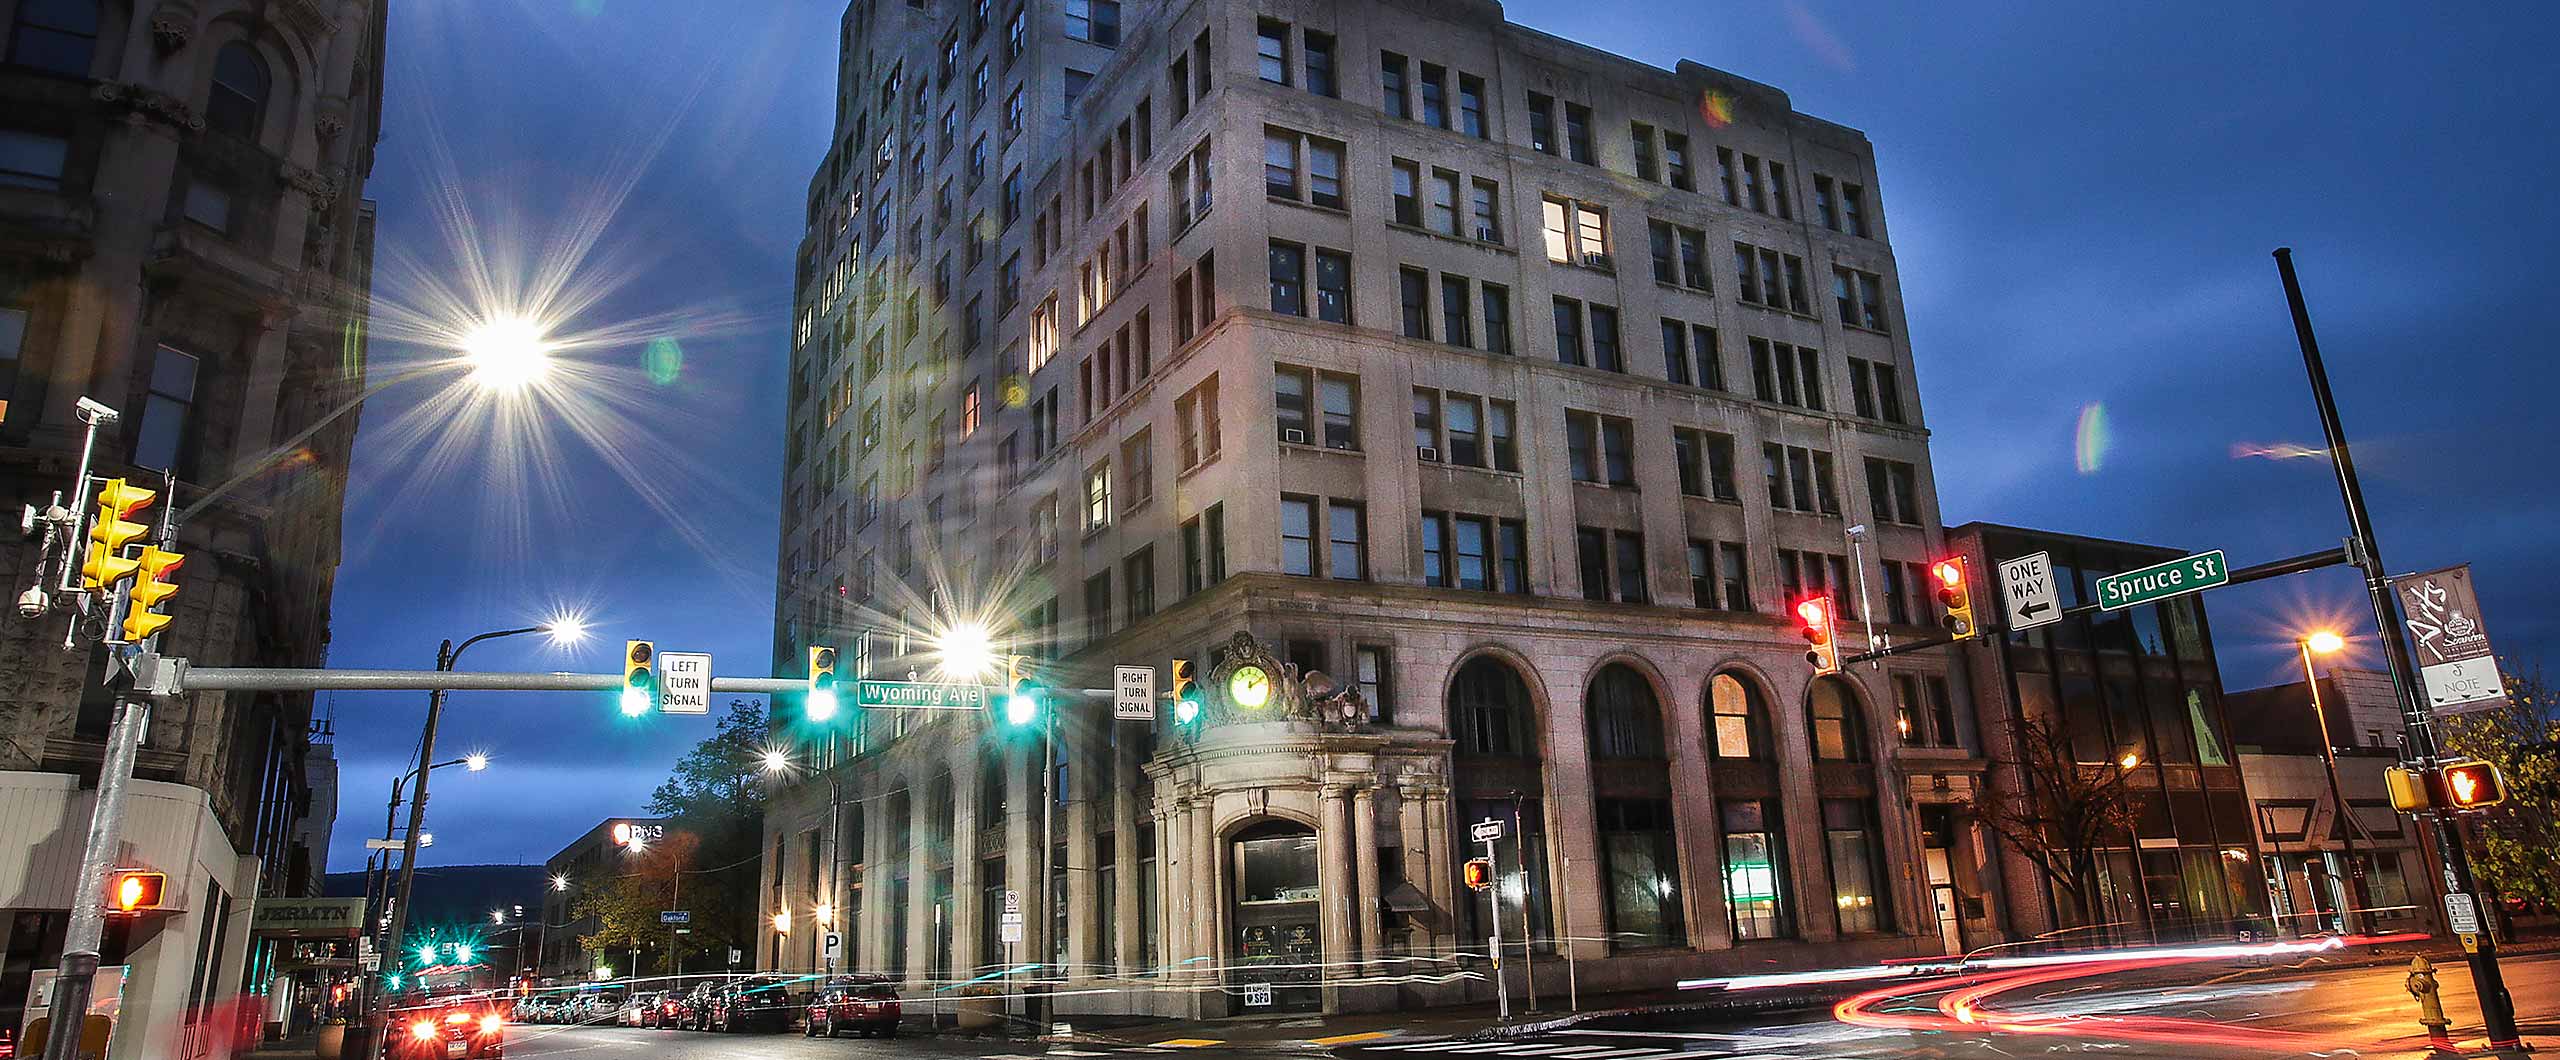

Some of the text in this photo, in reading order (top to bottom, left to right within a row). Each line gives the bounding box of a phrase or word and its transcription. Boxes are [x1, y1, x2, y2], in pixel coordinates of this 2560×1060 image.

[2010, 560, 2042, 582] ONE
[2107, 557, 2217, 602] Spruce St
[2011, 578, 2044, 600] WAY
[671, 661, 698, 672] LEFT
[670, 677, 699, 688] TURN
[1122, 672, 1147, 683] RIGHT
[1124, 687, 1147, 697] TURN
[2444, 678, 2481, 694] NOTE
[662, 694, 703, 705] SIGNAL
[864, 684, 978, 704] Wyoming Ave
[1119, 702, 1150, 712] SIGNAL
[258, 906, 350, 921] JERMYN
[826, 935, 839, 955] P
